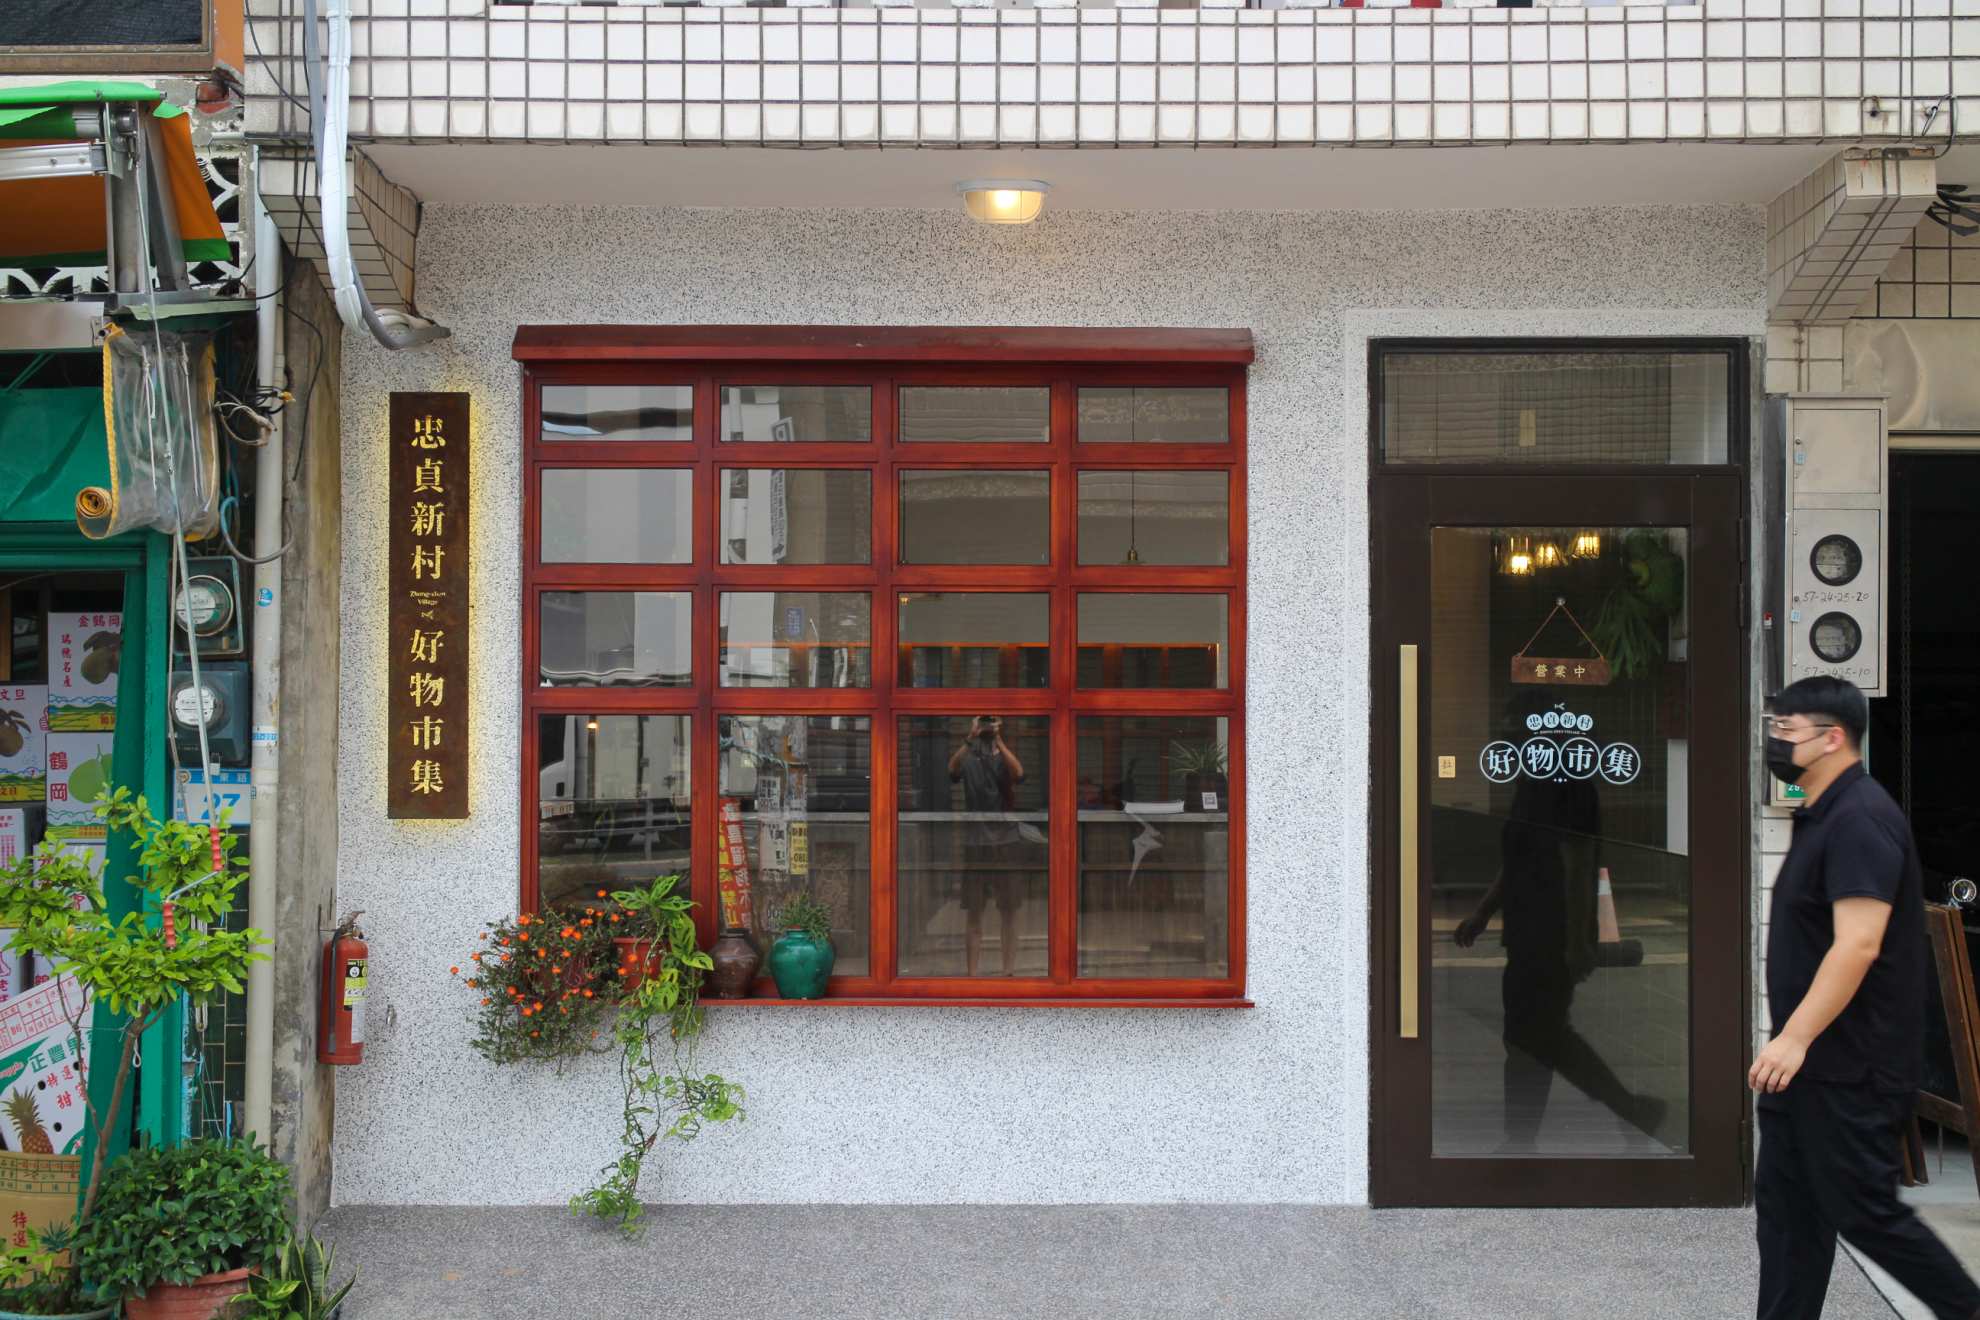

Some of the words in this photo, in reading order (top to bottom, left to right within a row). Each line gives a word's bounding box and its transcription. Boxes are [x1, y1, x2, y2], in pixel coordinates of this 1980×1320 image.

[410, 415, 446, 580] 忠貞新村
[1535, 663, 1586, 678] 營業中
[409, 629, 445, 794] 好物市集
[1527, 712, 1592, 730] 忠貞新村
[49, 751, 68, 801] 鶴岡
[1485, 743, 1634, 779] 好物市集
[201, 792, 241, 820] 27
[11, 1210, 28, 1248] 特選
